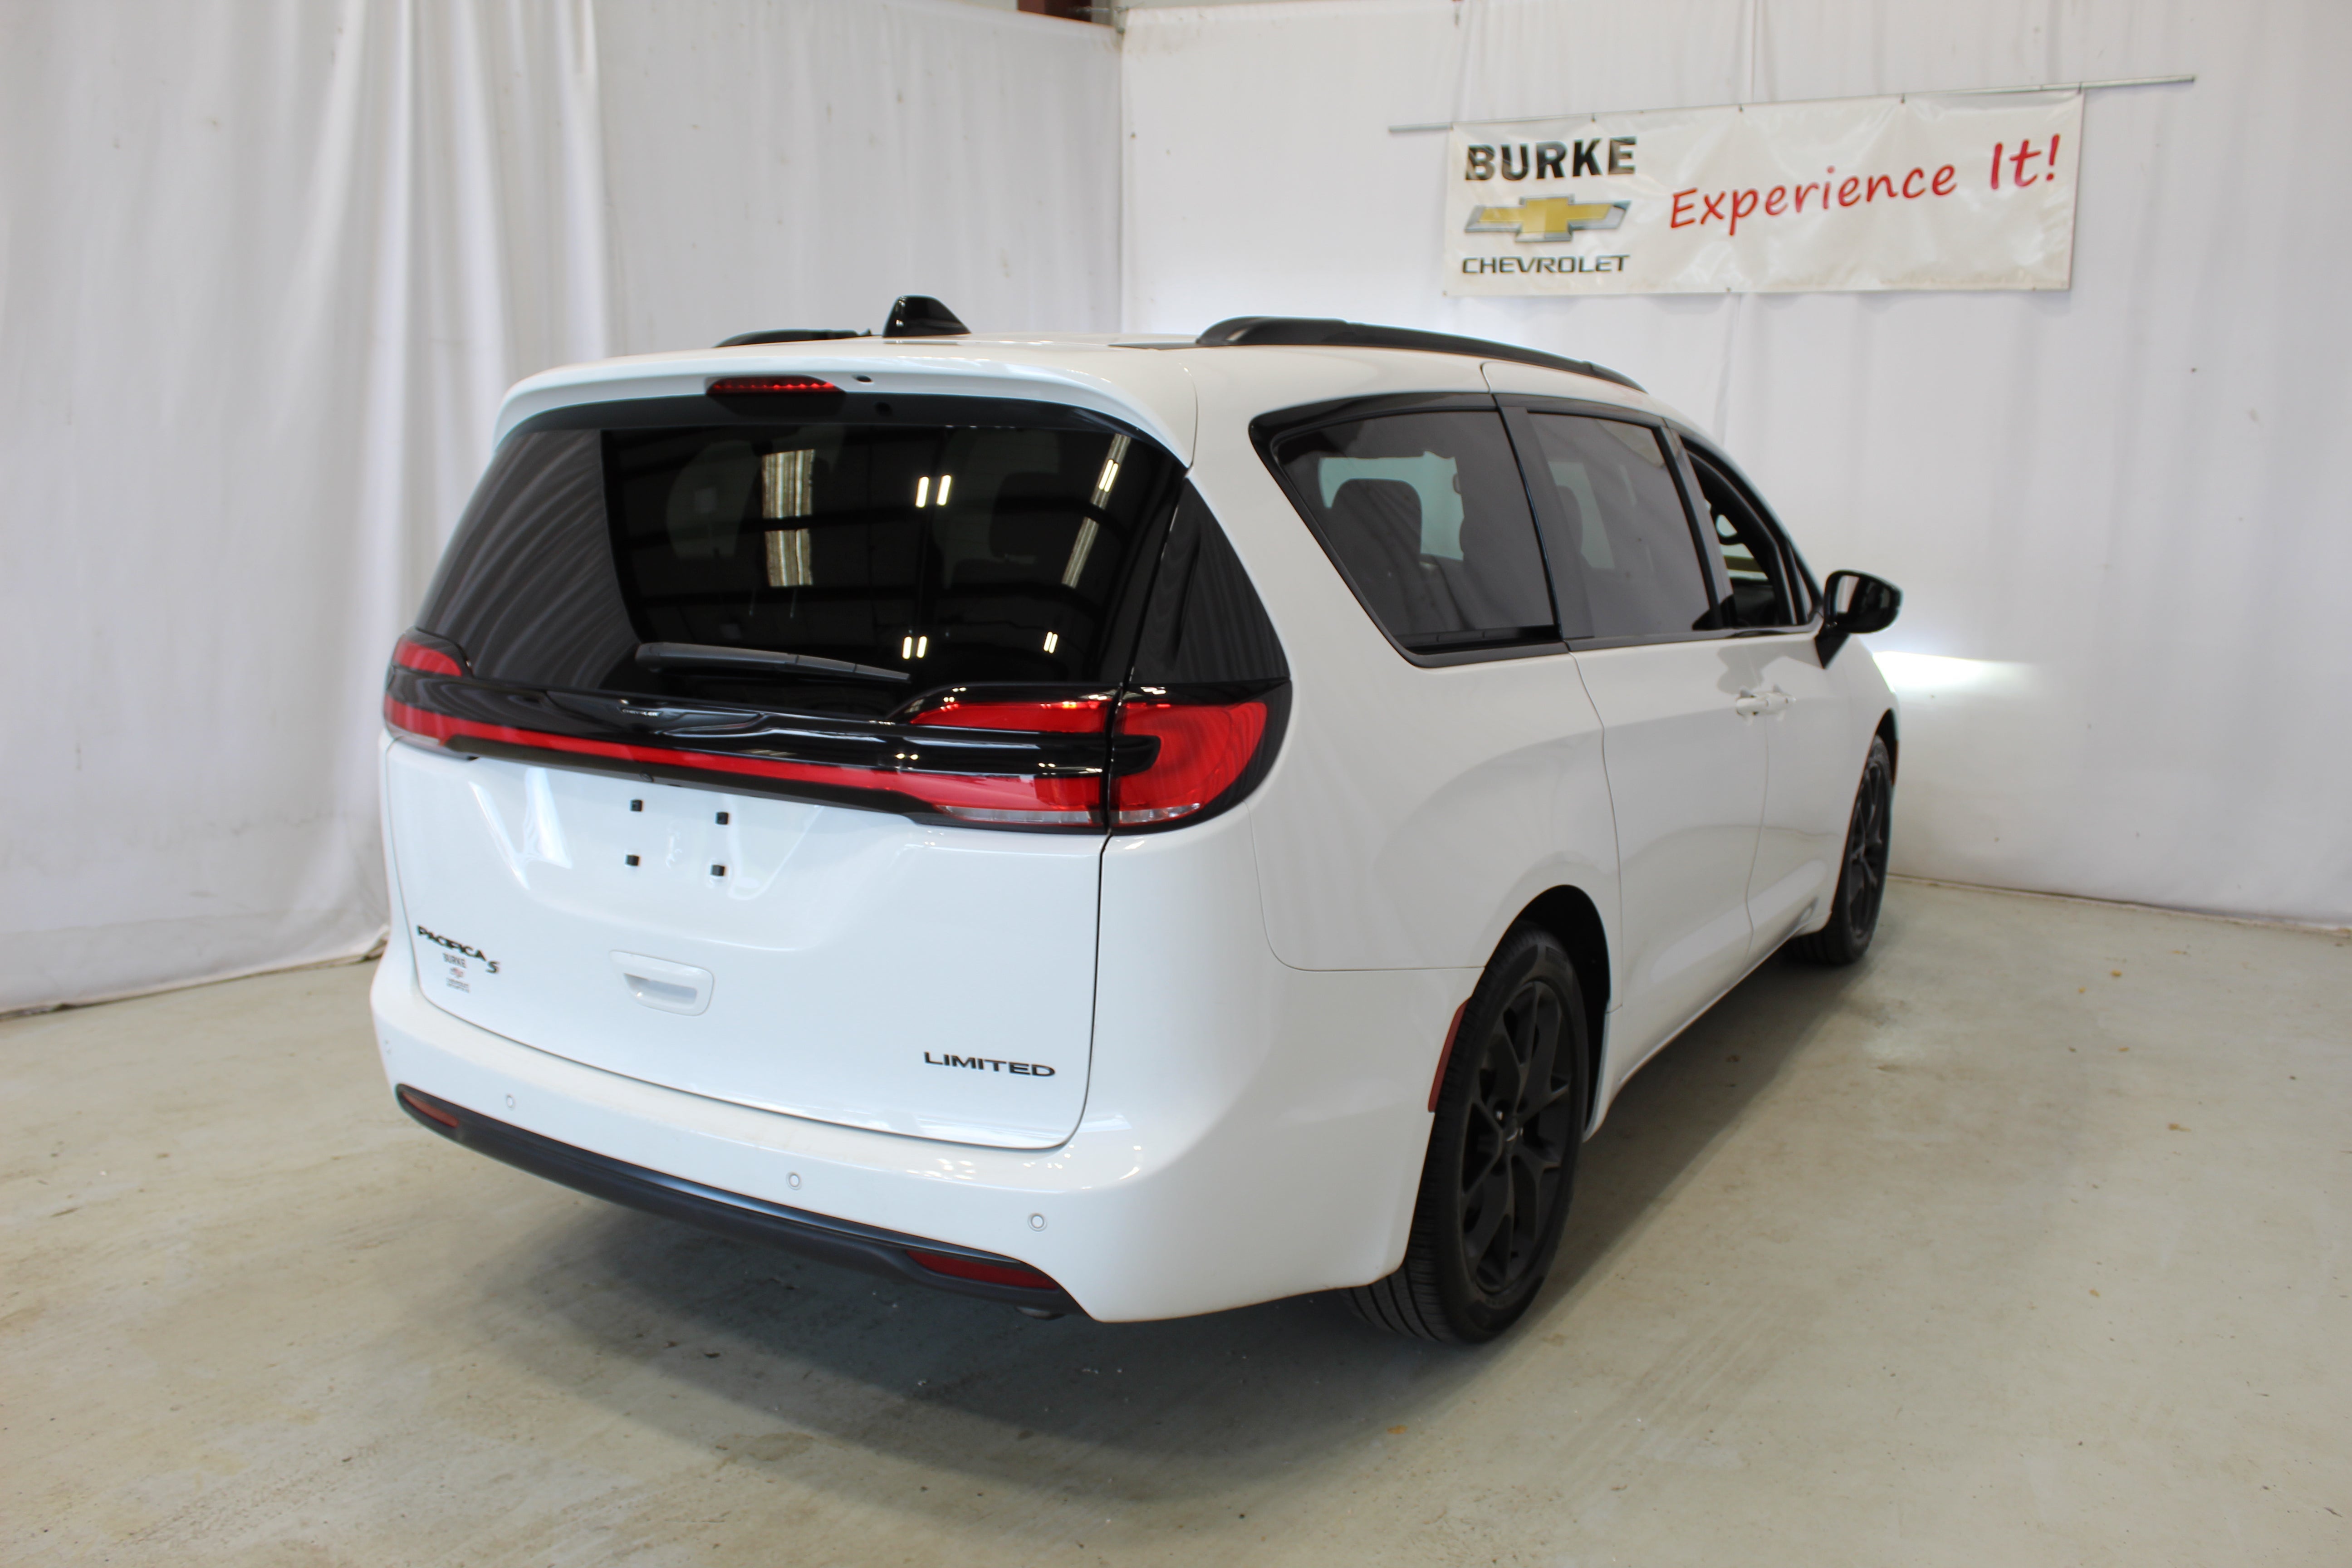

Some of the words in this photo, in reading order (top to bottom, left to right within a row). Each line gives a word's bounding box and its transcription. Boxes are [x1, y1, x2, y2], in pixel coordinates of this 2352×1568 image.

[1465, 137, 1636, 181] BURKE
[1670, 164, 1957, 236] Experience
[1990, 134, 2060, 190] It!
[1462, 255, 1630, 274] CHEVROLET
[417, 925, 486, 961] PACIFICA
[486, 961, 499, 973] S
[924, 1052, 1055, 1077] LIMITED
